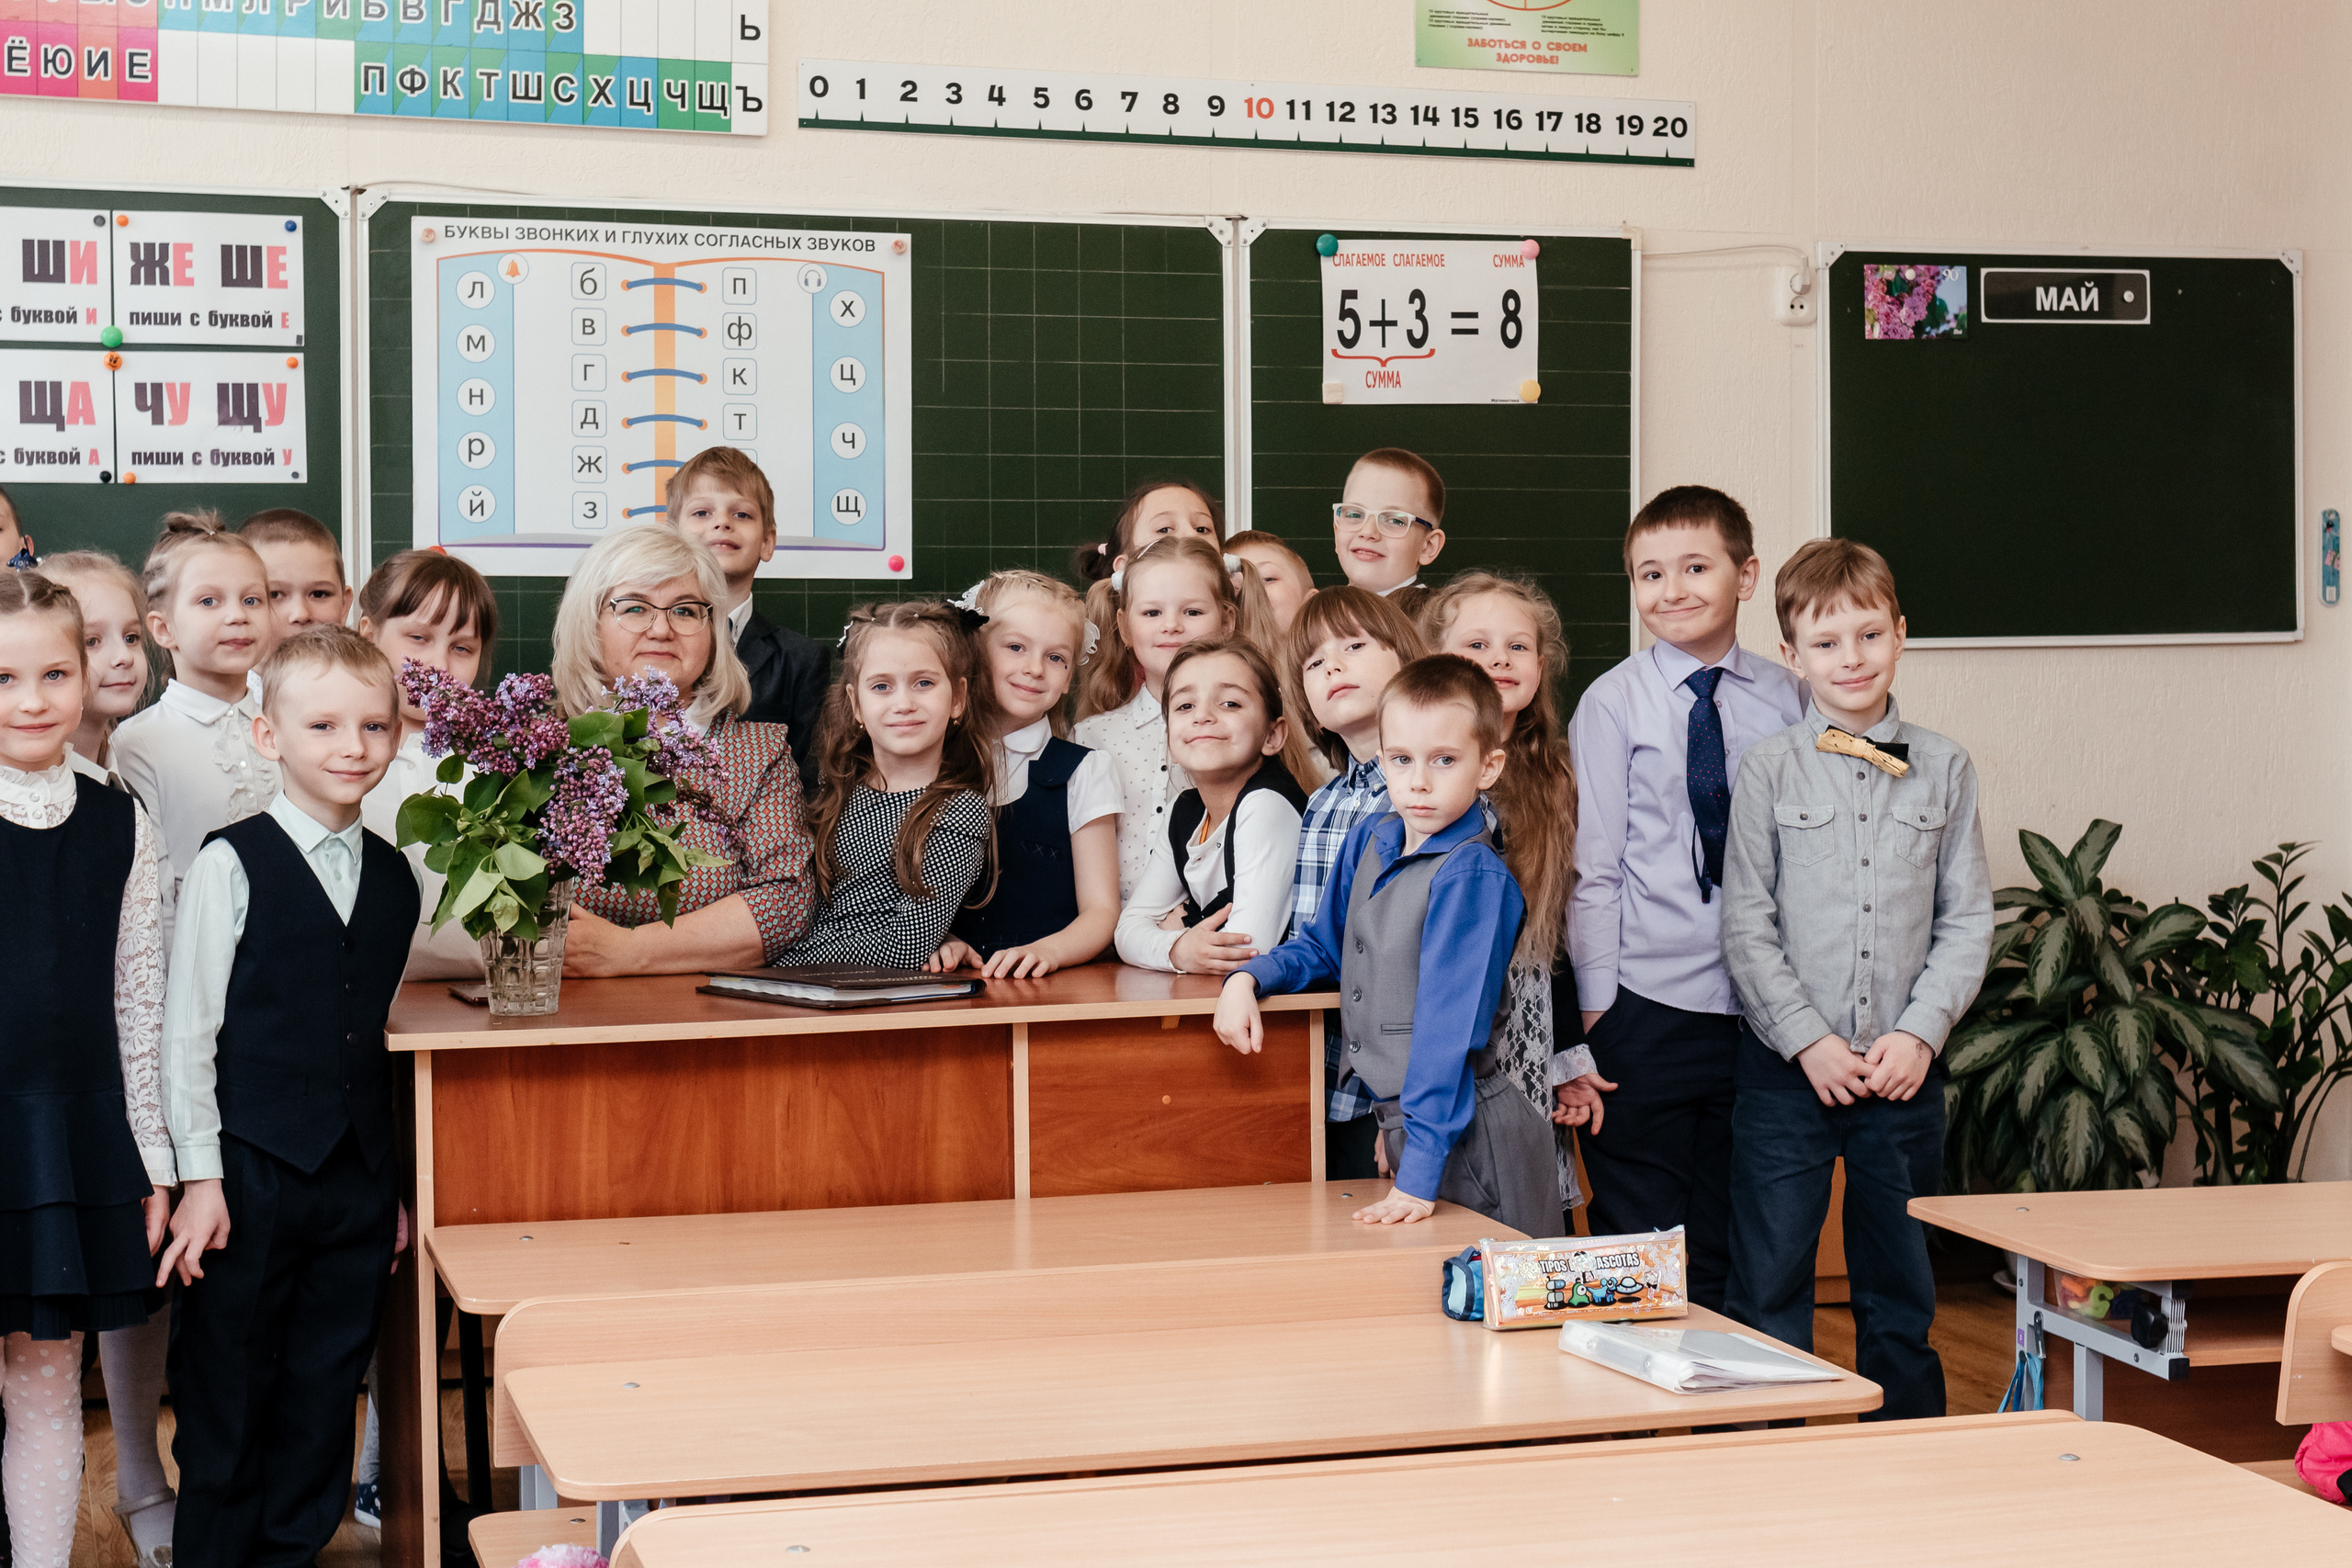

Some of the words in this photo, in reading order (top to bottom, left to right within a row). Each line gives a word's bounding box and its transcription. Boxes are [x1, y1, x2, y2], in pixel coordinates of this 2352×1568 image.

[401, 0, 426, 22] В
[442, 0, 464, 24] Г
[474, 0, 503, 33] Д
[510, 0, 544, 29] Ж
[553, 1, 575, 31] З
[741, 14, 761, 41] Ь
[1467, 38, 1527, 51] ЗАБОТЬСЯ
[1531, 39, 1542, 51] О
[1546, 41, 1588, 53] СВОЕМ
[1496, 52, 1559, 65] ЗДОРОВЬЕ!
[6, 38, 28, 74] Ё
[43, 47, 73, 76] Ю
[86, 49, 109, 78] И
[128, 51, 150, 80] Е
[363, 64, 385, 94] П
[397, 65, 428, 96] Ф
[441, 67, 463, 98] К
[477, 71, 501, 100] Т
[511, 73, 543, 102] Ш
[553, 74, 576, 104] С
[590, 77, 614, 106] Х
[628, 79, 652, 114] Ц
[665, 81, 686, 109] Ч
[697, 83, 729, 118] Щ
[734, 85, 763, 113] Ъ
[809, 75, 829, 98] 0
[855, 78, 865, 100] 1
[899, 80, 918, 103] 2
[945, 82, 963, 105] 3
[988, 85, 1006, 107] 4
[1033, 86, 1050, 109] 5
[1075, 88, 1093, 111] 6
[1121, 91, 1139, 113] 7
[1162, 93, 1180, 115] 8
[1207, 95, 1226, 118] 9
[1244, 96, 1275, 119] 10
[1285, 98, 1311, 121] 11
[1326, 100, 1356, 123] 12
[1369, 103, 1397, 125] 13
[1409, 105, 1441, 127] 14
[1451, 107, 1479, 129] 15
[1493, 108, 1523, 130] 16
[1535, 110, 1564, 132] 17
[1574, 112, 1602, 134] 18
[1615, 114, 1645, 136] 19
[1652, 116, 1688, 139] 20
[444, 225, 509, 240] БУКВЫ
[514, 227, 599, 243] ЗВОНКИХ
[605, 230, 616, 243] И
[621, 231, 690, 246] ГЛУХИХ
[694, 232, 802, 250] СОГЛАСНЫХ
[807, 236, 876, 253] ЗВУКОВ
[21, 238, 97, 285] ШИ
[129, 242, 195, 287] ЖЕ
[220, 243, 288, 289] ШЕ
[1332, 253, 1386, 267] СЛАГАЕМОЕ
[1393, 253, 1445, 267] СЛАГАЕМОЕ
[1493, 254, 1525, 268] СУММА
[2035, 281, 2099, 312] МАЙ
[10, 306, 78, 325] буквой
[85, 308, 97, 325] И
[129, 311, 182, 326] пиши
[189, 312, 200, 327] с
[208, 310, 273, 329] буквой
[280, 311, 289, 329] Е
[1499, 288, 1523, 349] 8
[1365, 370, 1402, 389] СУММА
[18, 380, 96, 433] ЩА
[133, 381, 191, 426] ЧУ
[216, 382, 288, 434] ЩУ
[14, 446, 81, 467] буквой
[88, 448, 100, 466] А
[131, 451, 184, 466] пиши
[191, 451, 202, 466] с
[209, 447, 275, 468] буквой
[282, 448, 292, 466] У
[1539, 1258, 1568, 1274] TIPOS
